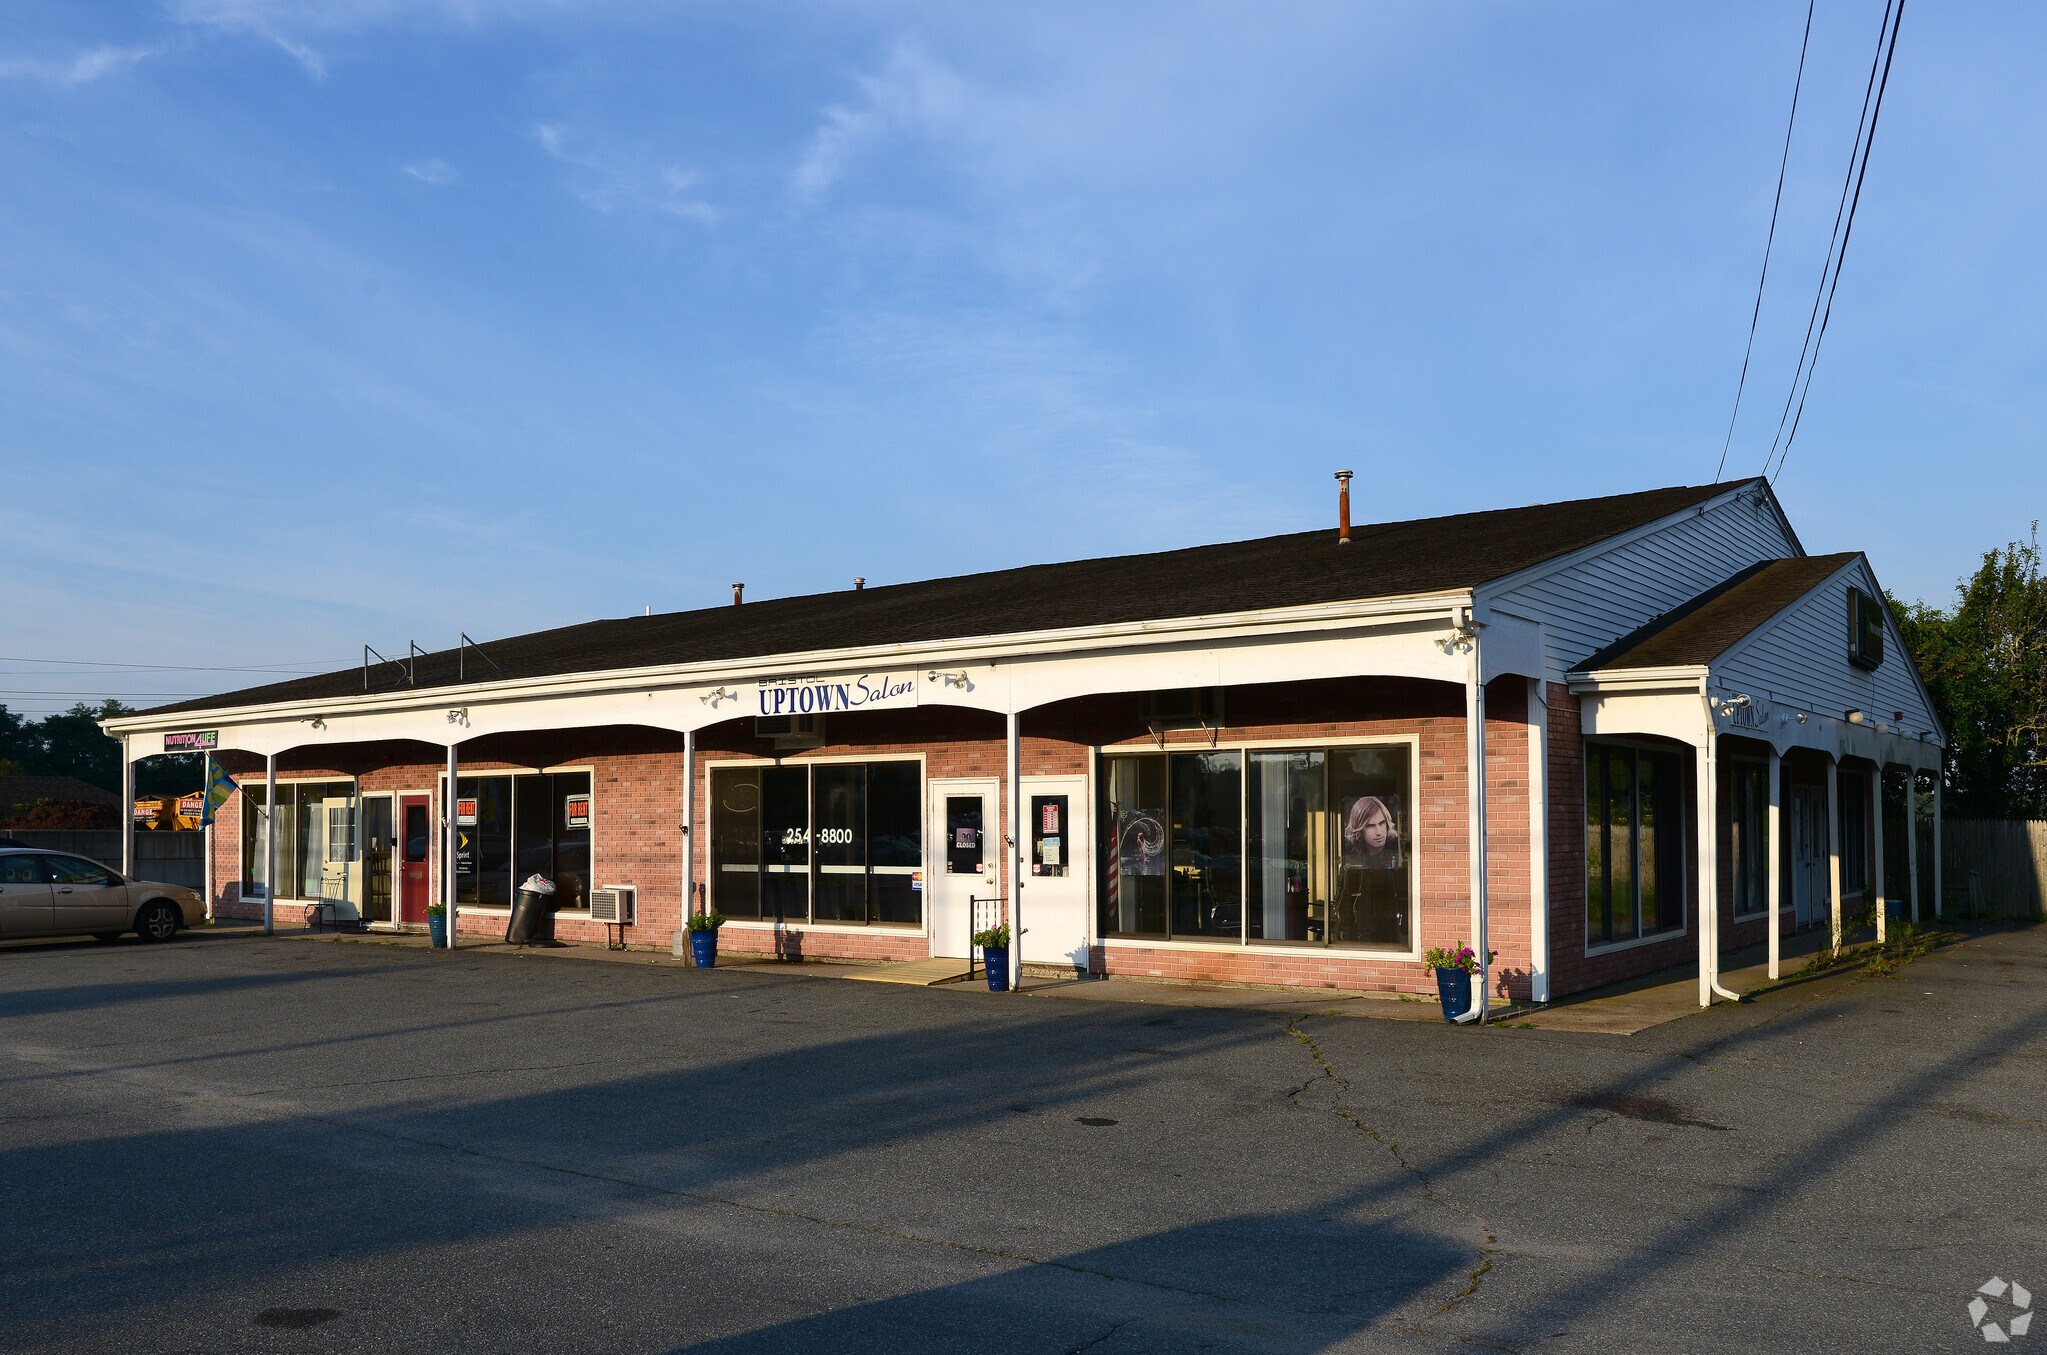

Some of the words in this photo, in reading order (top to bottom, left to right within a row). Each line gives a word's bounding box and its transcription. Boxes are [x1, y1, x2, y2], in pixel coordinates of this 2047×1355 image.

[758, 676, 825, 687] BRISTOL
[759, 684, 850, 715] UPTOWN
[850, 674, 915, 706] Salon
[578, 802, 588, 816] RENT
[456, 852, 470, 860] Sprint
